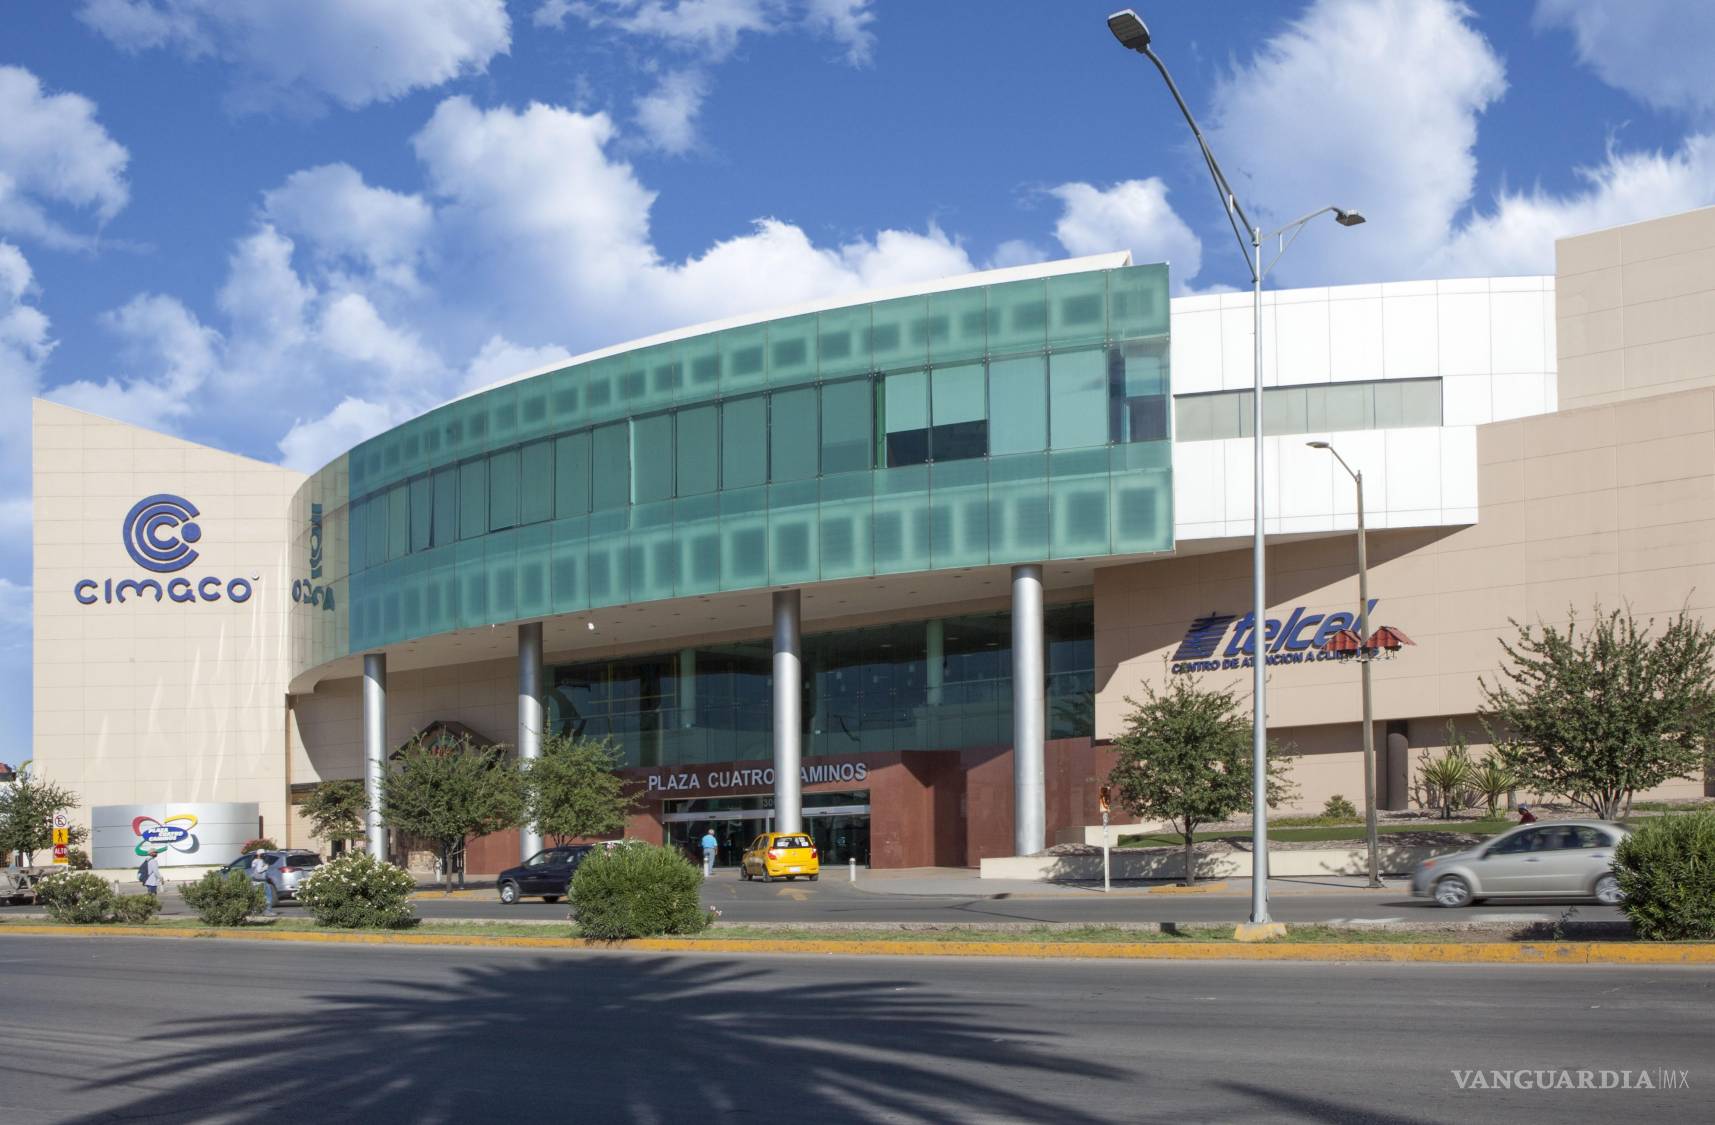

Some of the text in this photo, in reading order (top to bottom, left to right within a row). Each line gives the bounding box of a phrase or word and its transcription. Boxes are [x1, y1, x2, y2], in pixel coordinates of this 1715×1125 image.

[1171, 660, 1220, 674] CENTRO
[1222, 658, 1239, 670] DE
[1241, 651, 1303, 668] ATNCION
[648, 762, 868, 791] PLAZA CUATRO AMINOS
